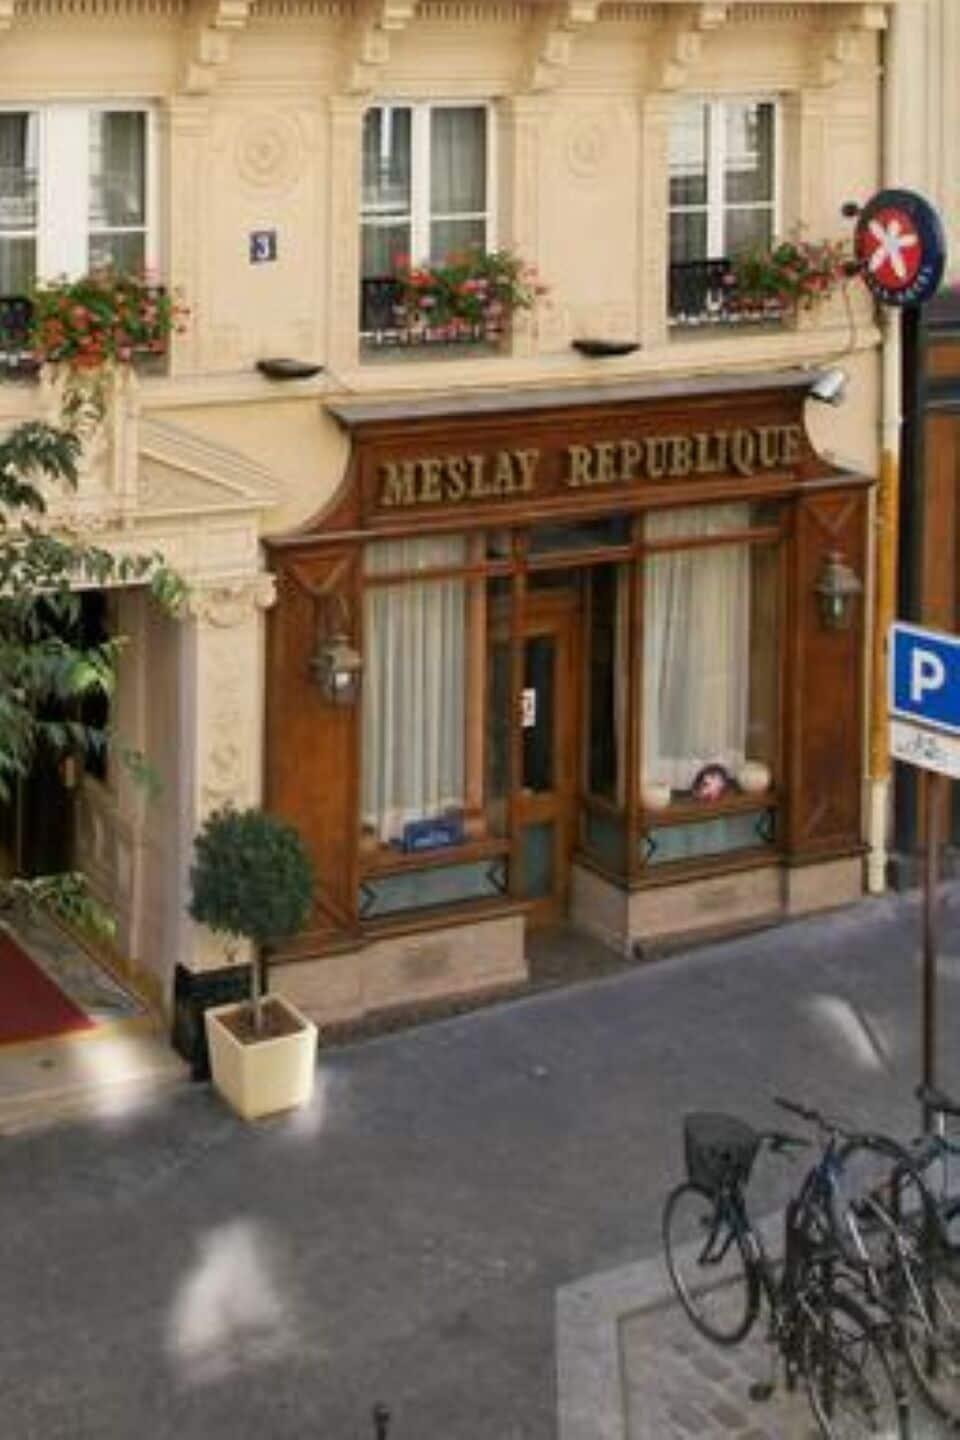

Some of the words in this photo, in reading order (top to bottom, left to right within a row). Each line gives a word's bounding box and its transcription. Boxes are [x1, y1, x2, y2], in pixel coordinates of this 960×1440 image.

[255, 235, 270, 259] 3
[381, 447, 540, 506] MESLAY
[567, 425, 802, 488] REPUBLIQUE
[911, 647, 946, 702] P
